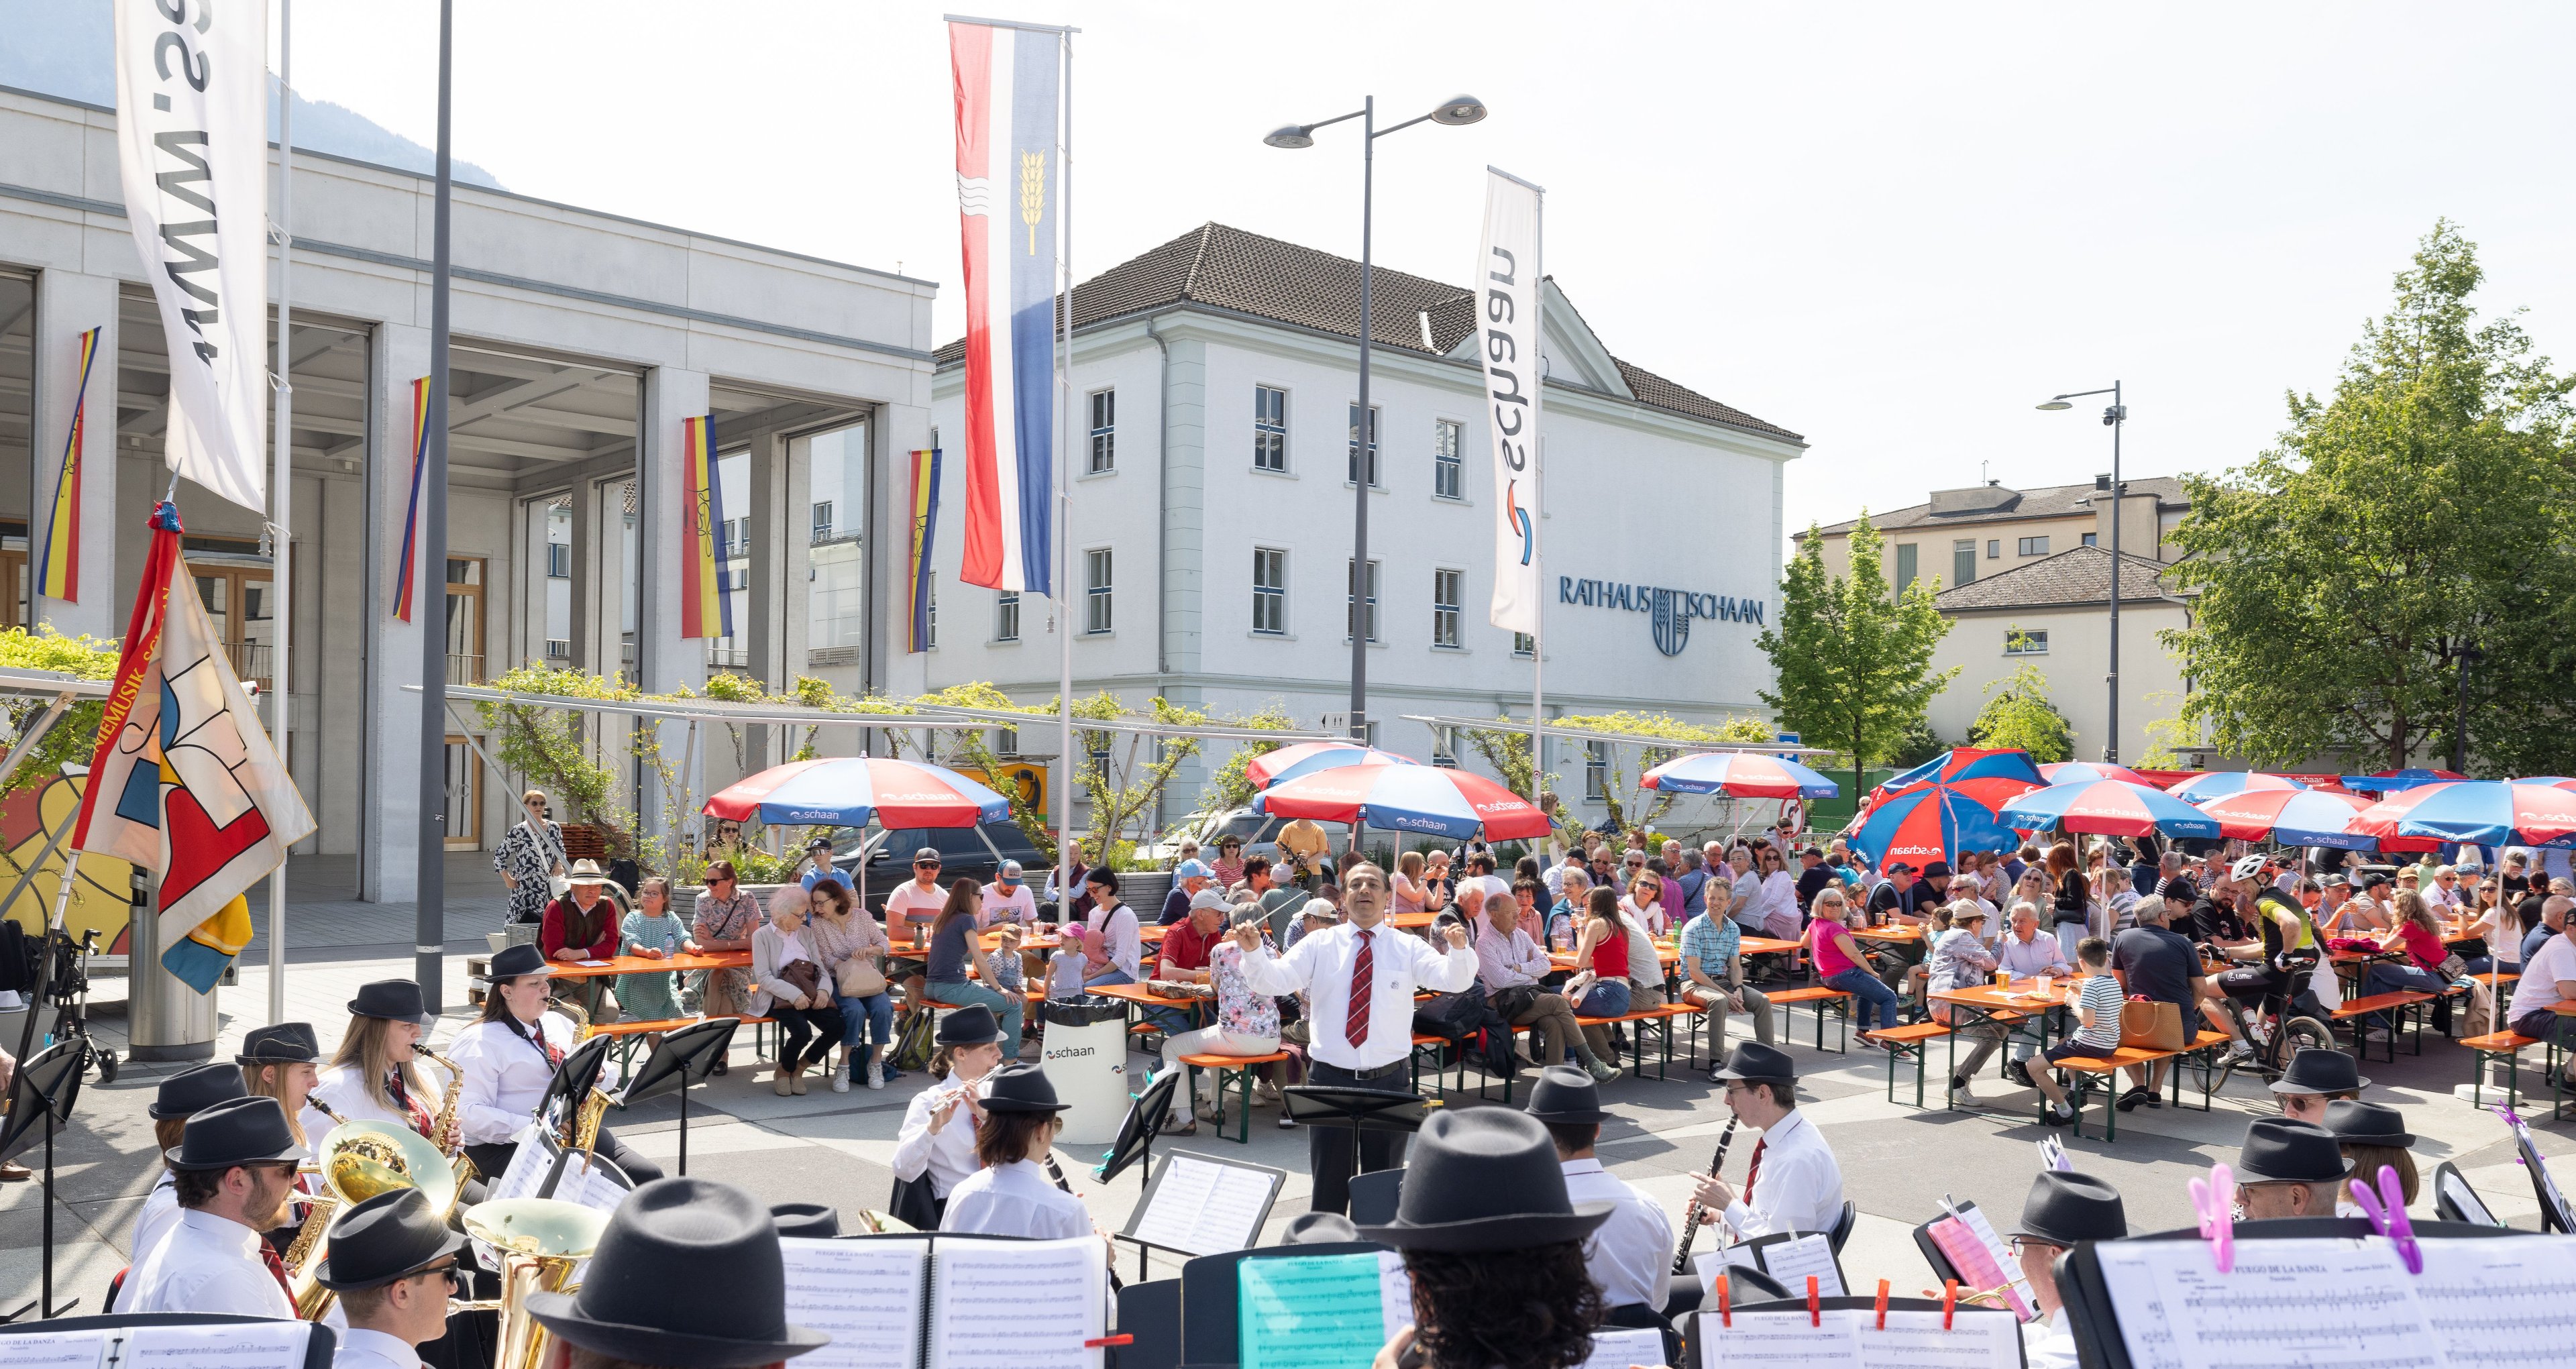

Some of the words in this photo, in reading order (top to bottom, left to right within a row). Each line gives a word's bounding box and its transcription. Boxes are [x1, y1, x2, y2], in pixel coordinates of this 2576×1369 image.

[1560, 576, 1651, 612] RATHAUS
[1689, 592, 1764, 624] SCHAAN
[443, 783, 470, 798] WC
[1685, 783, 1706, 791] schaan
[902, 790, 958, 802] schaan
[1491, 800, 1527, 811] schaan
[804, 810, 839, 820] schaan
[2094, 807, 2149, 818] schaan
[2226, 811, 2272, 821] schaan
[1411, 817, 1447, 831] schaan
[2026, 814, 2047, 823] schaan
[2184, 822, 2206, 830] schaan
[2316, 836, 2349, 846] schaan
[1056, 1046, 1095, 1058] schaan
